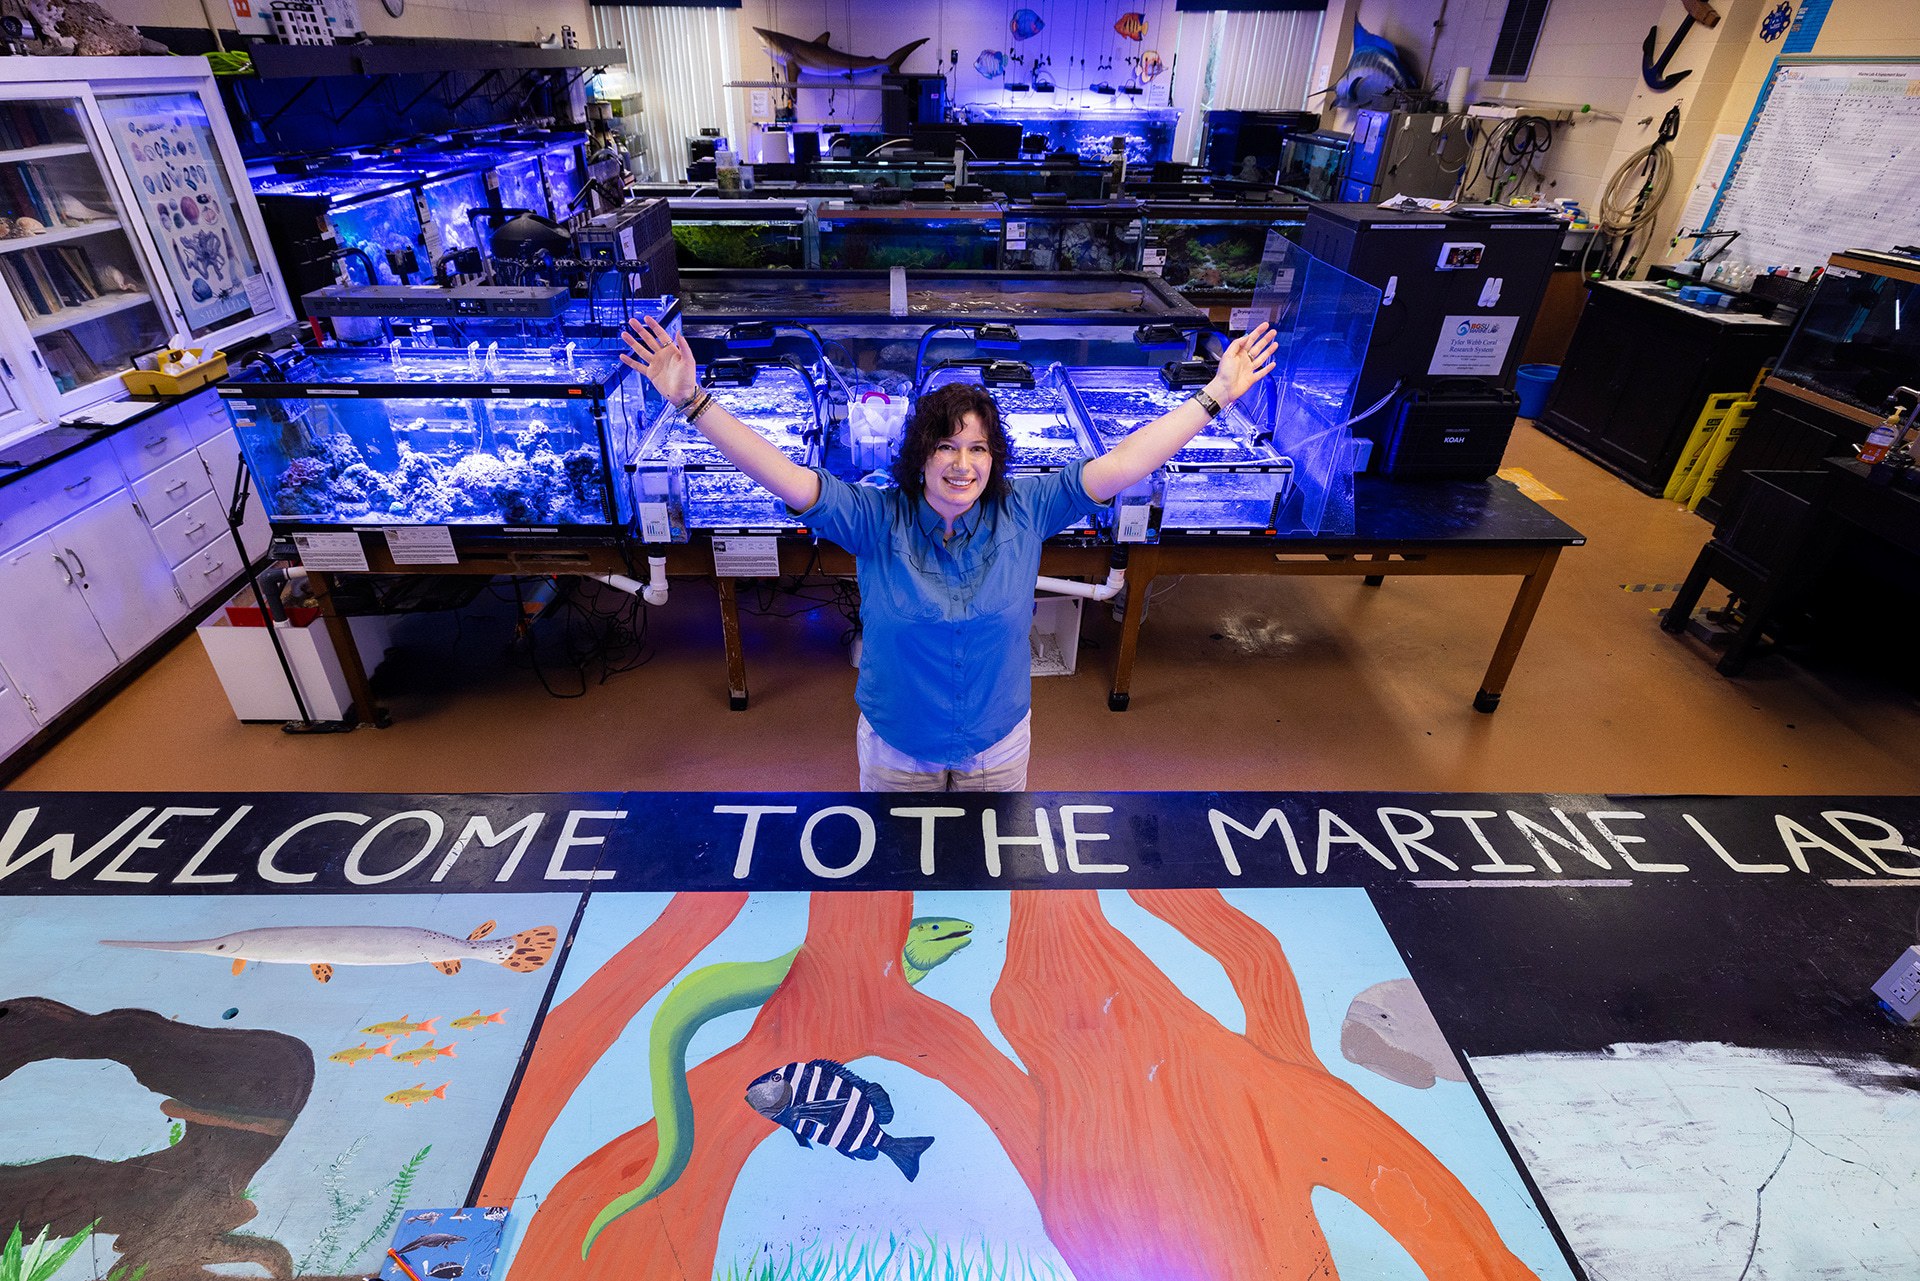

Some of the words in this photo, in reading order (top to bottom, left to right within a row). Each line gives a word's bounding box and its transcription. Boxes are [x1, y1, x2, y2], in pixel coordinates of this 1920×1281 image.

[1474, 346, 1494, 354] System
[0, 805, 628, 885] WELCOME
[1208, 806, 1690, 875] MARINE
[1683, 810, 1920, 877] LAB
